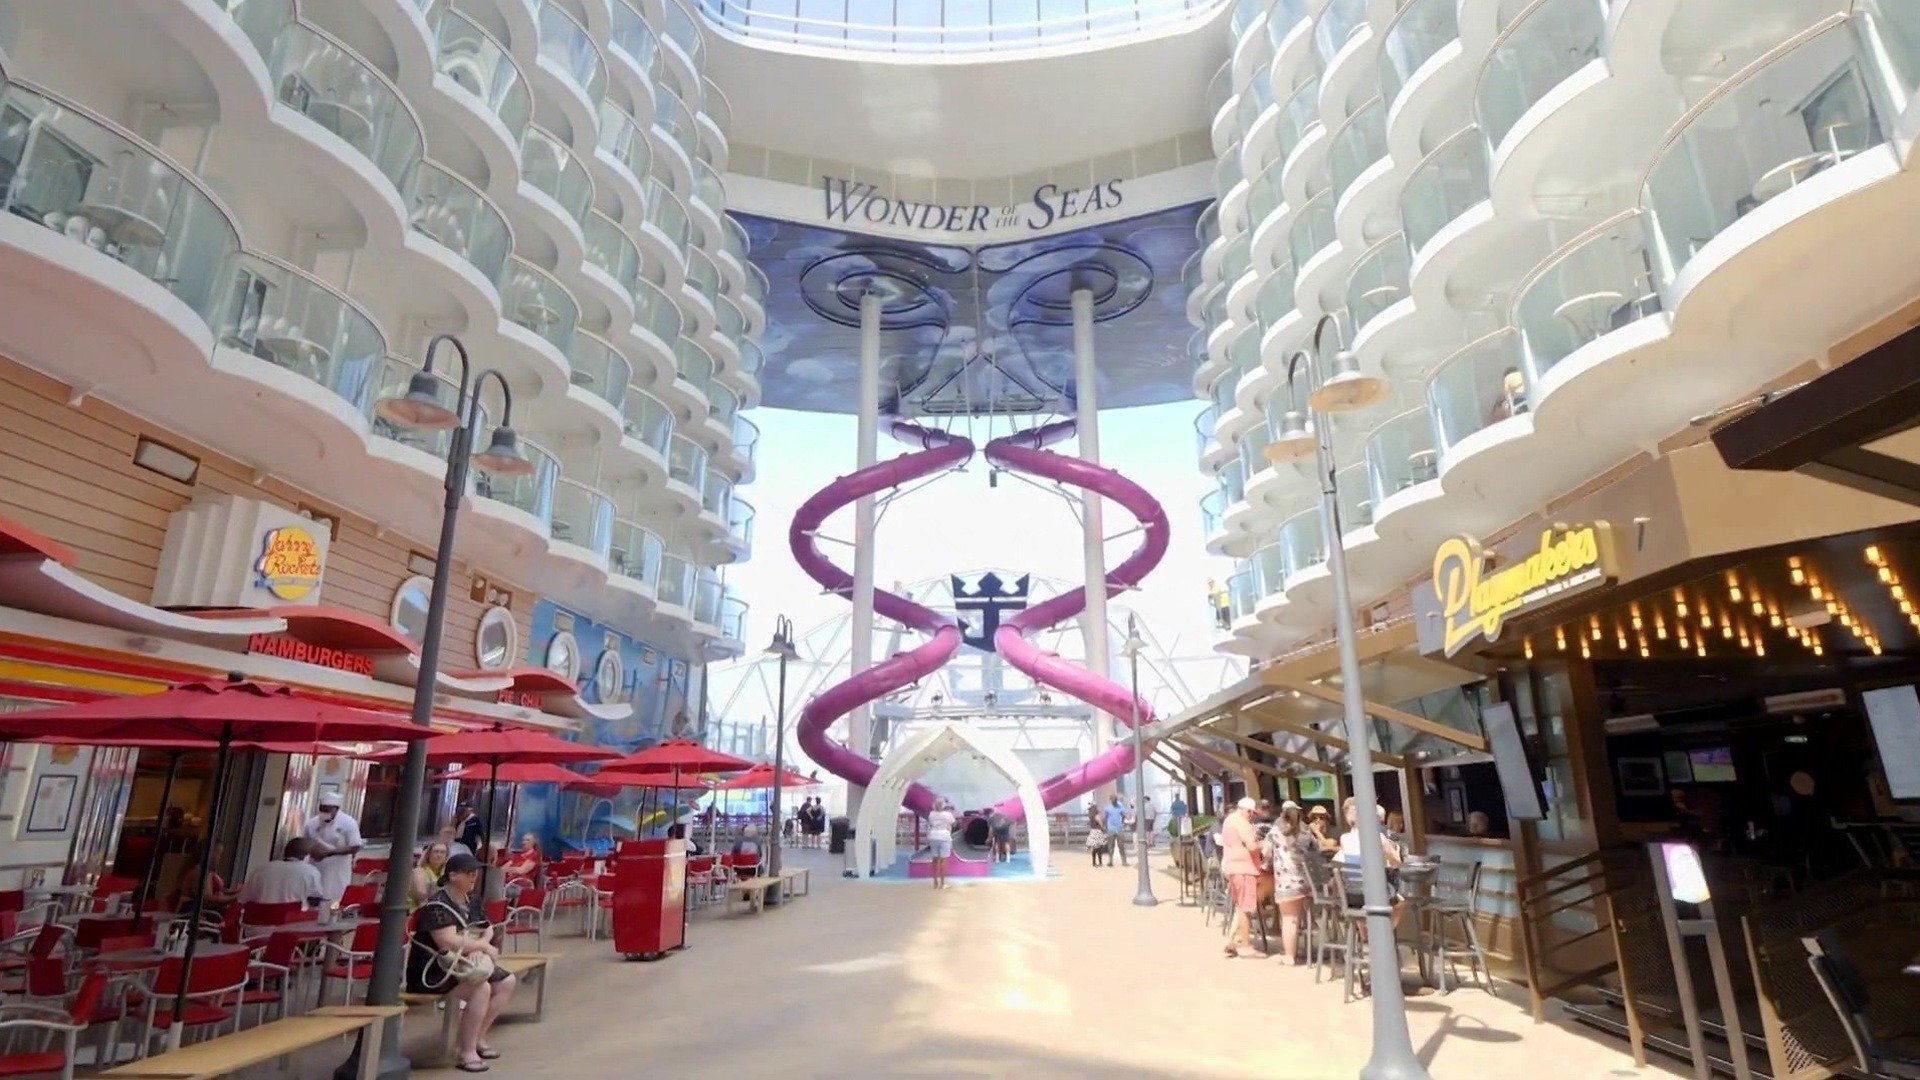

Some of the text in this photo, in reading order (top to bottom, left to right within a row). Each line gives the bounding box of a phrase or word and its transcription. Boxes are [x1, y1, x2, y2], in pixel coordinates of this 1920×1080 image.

[822, 175, 990, 232] WONDER
[1027, 178, 1123, 229] SEAS
[265, 553, 321, 575] Rockets
[266, 531, 315, 563] Johnny
[1433, 528, 1598, 656] Playmakers
[249, 633, 373, 675] HAMBURGERS
